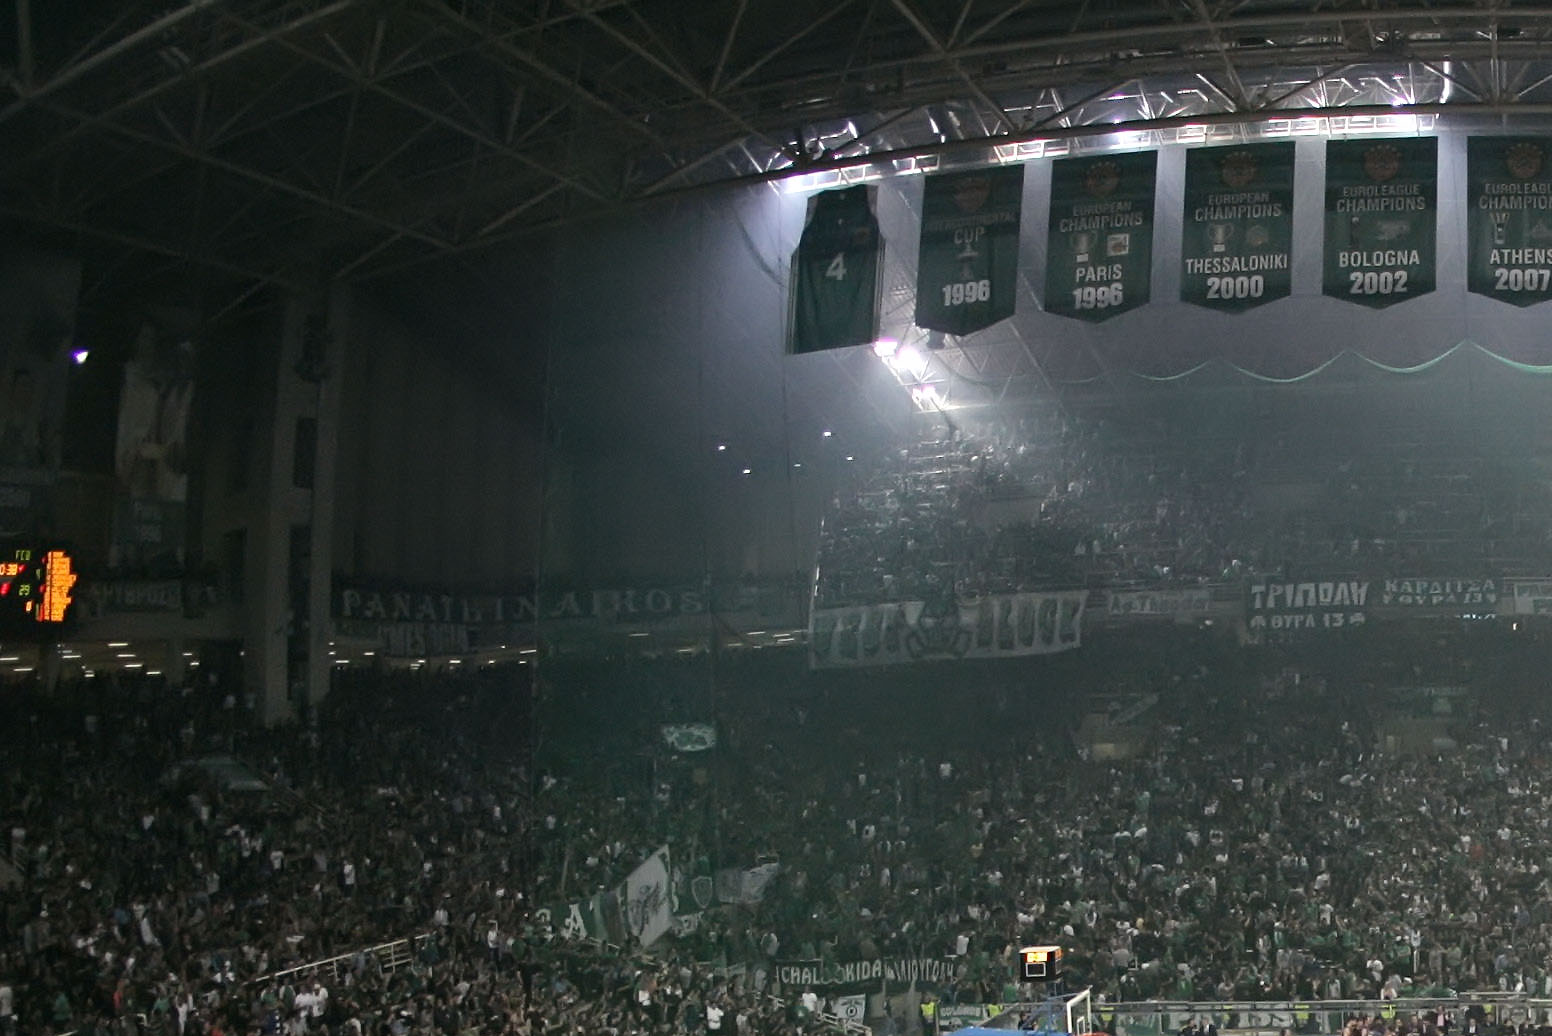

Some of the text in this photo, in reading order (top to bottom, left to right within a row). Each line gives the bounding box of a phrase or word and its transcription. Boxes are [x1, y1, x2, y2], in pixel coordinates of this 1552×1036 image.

[1195, 203, 1281, 221] CHAMPIONS
[1336, 196, 1425, 213] CHAMPIONS
[1060, 212, 1143, 232] CHAMPIONS
[954, 226, 984, 243] CUP
[826, 252, 847, 280] 4
[1186, 254, 1288, 274] THESSALONIKI
[1339, 250, 1420, 267] BOLOGNA
[1075, 264, 1122, 283] PARIS
[1350, 271, 1408, 294] 2002
[1495, 269, 1551, 291] 2007
[941, 280, 991, 307] 1996
[1073, 283, 1124, 309] 1996
[1206, 275, 1264, 299] 2000
